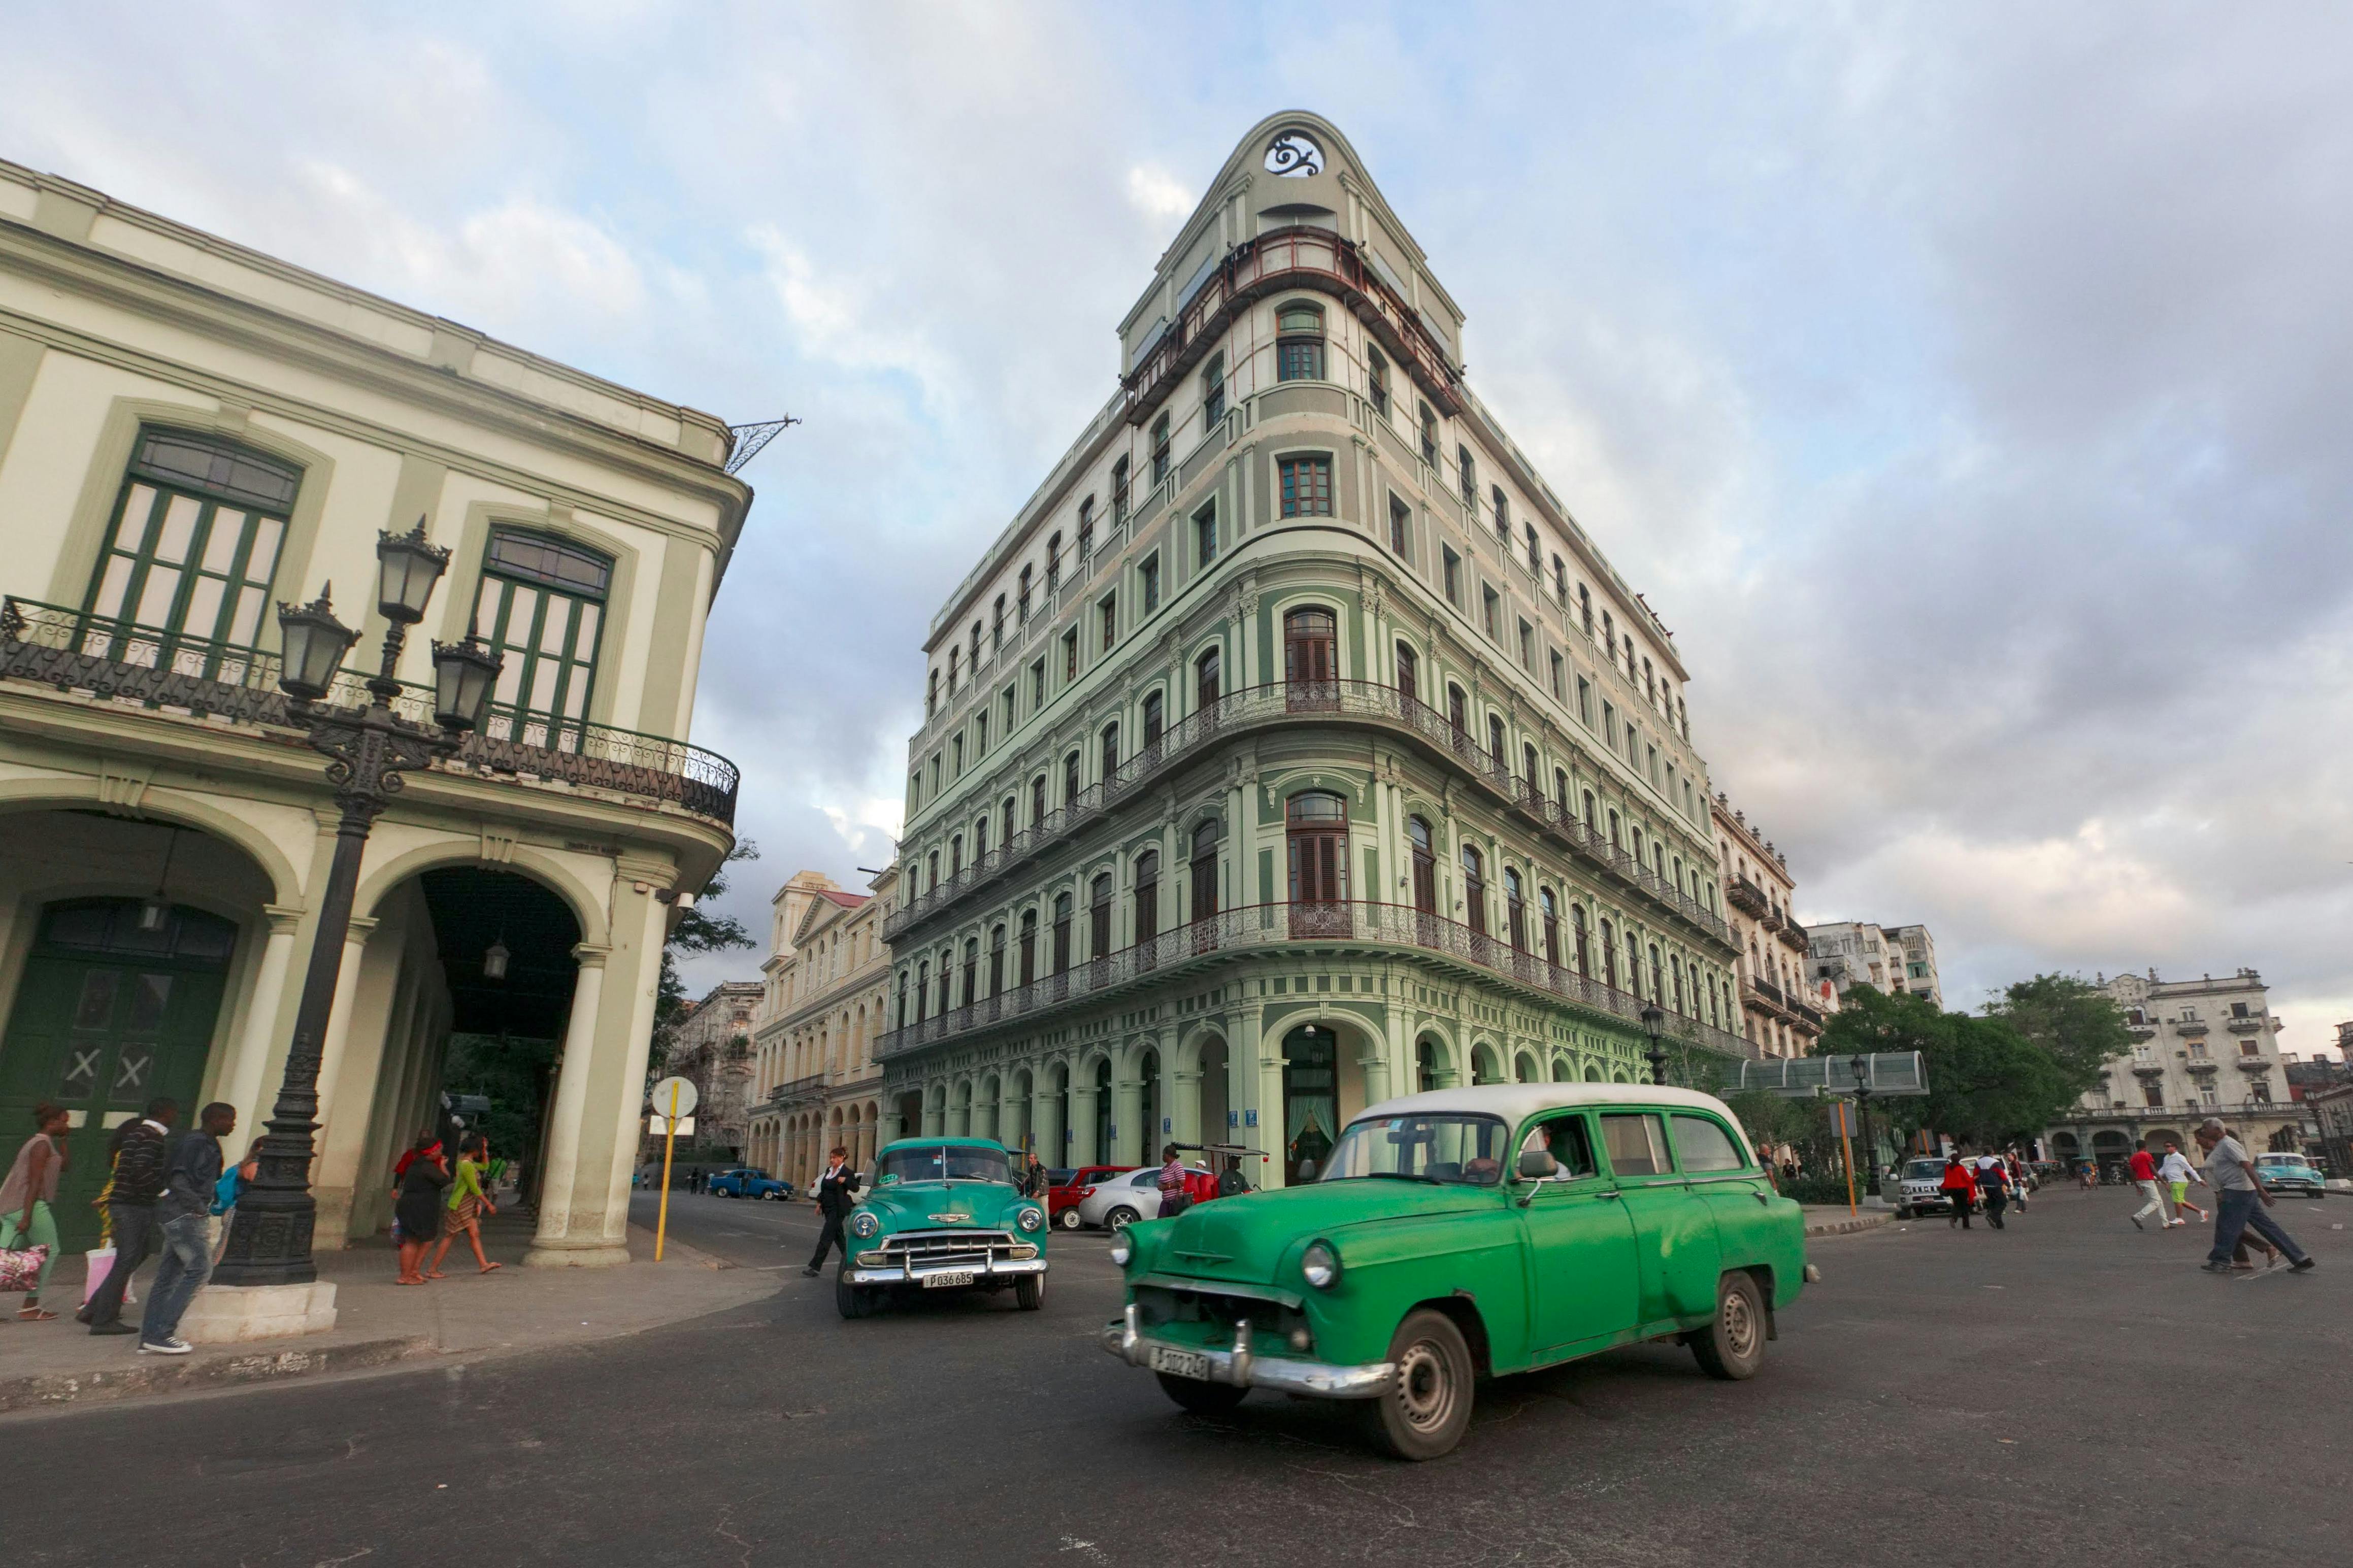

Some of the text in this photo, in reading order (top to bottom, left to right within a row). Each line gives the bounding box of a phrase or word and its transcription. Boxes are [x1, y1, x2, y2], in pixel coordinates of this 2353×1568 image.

[931, 1277, 936, 1286] P
[937, 1275, 954, 1286] 036
[955, 1273, 972, 1284] 685
